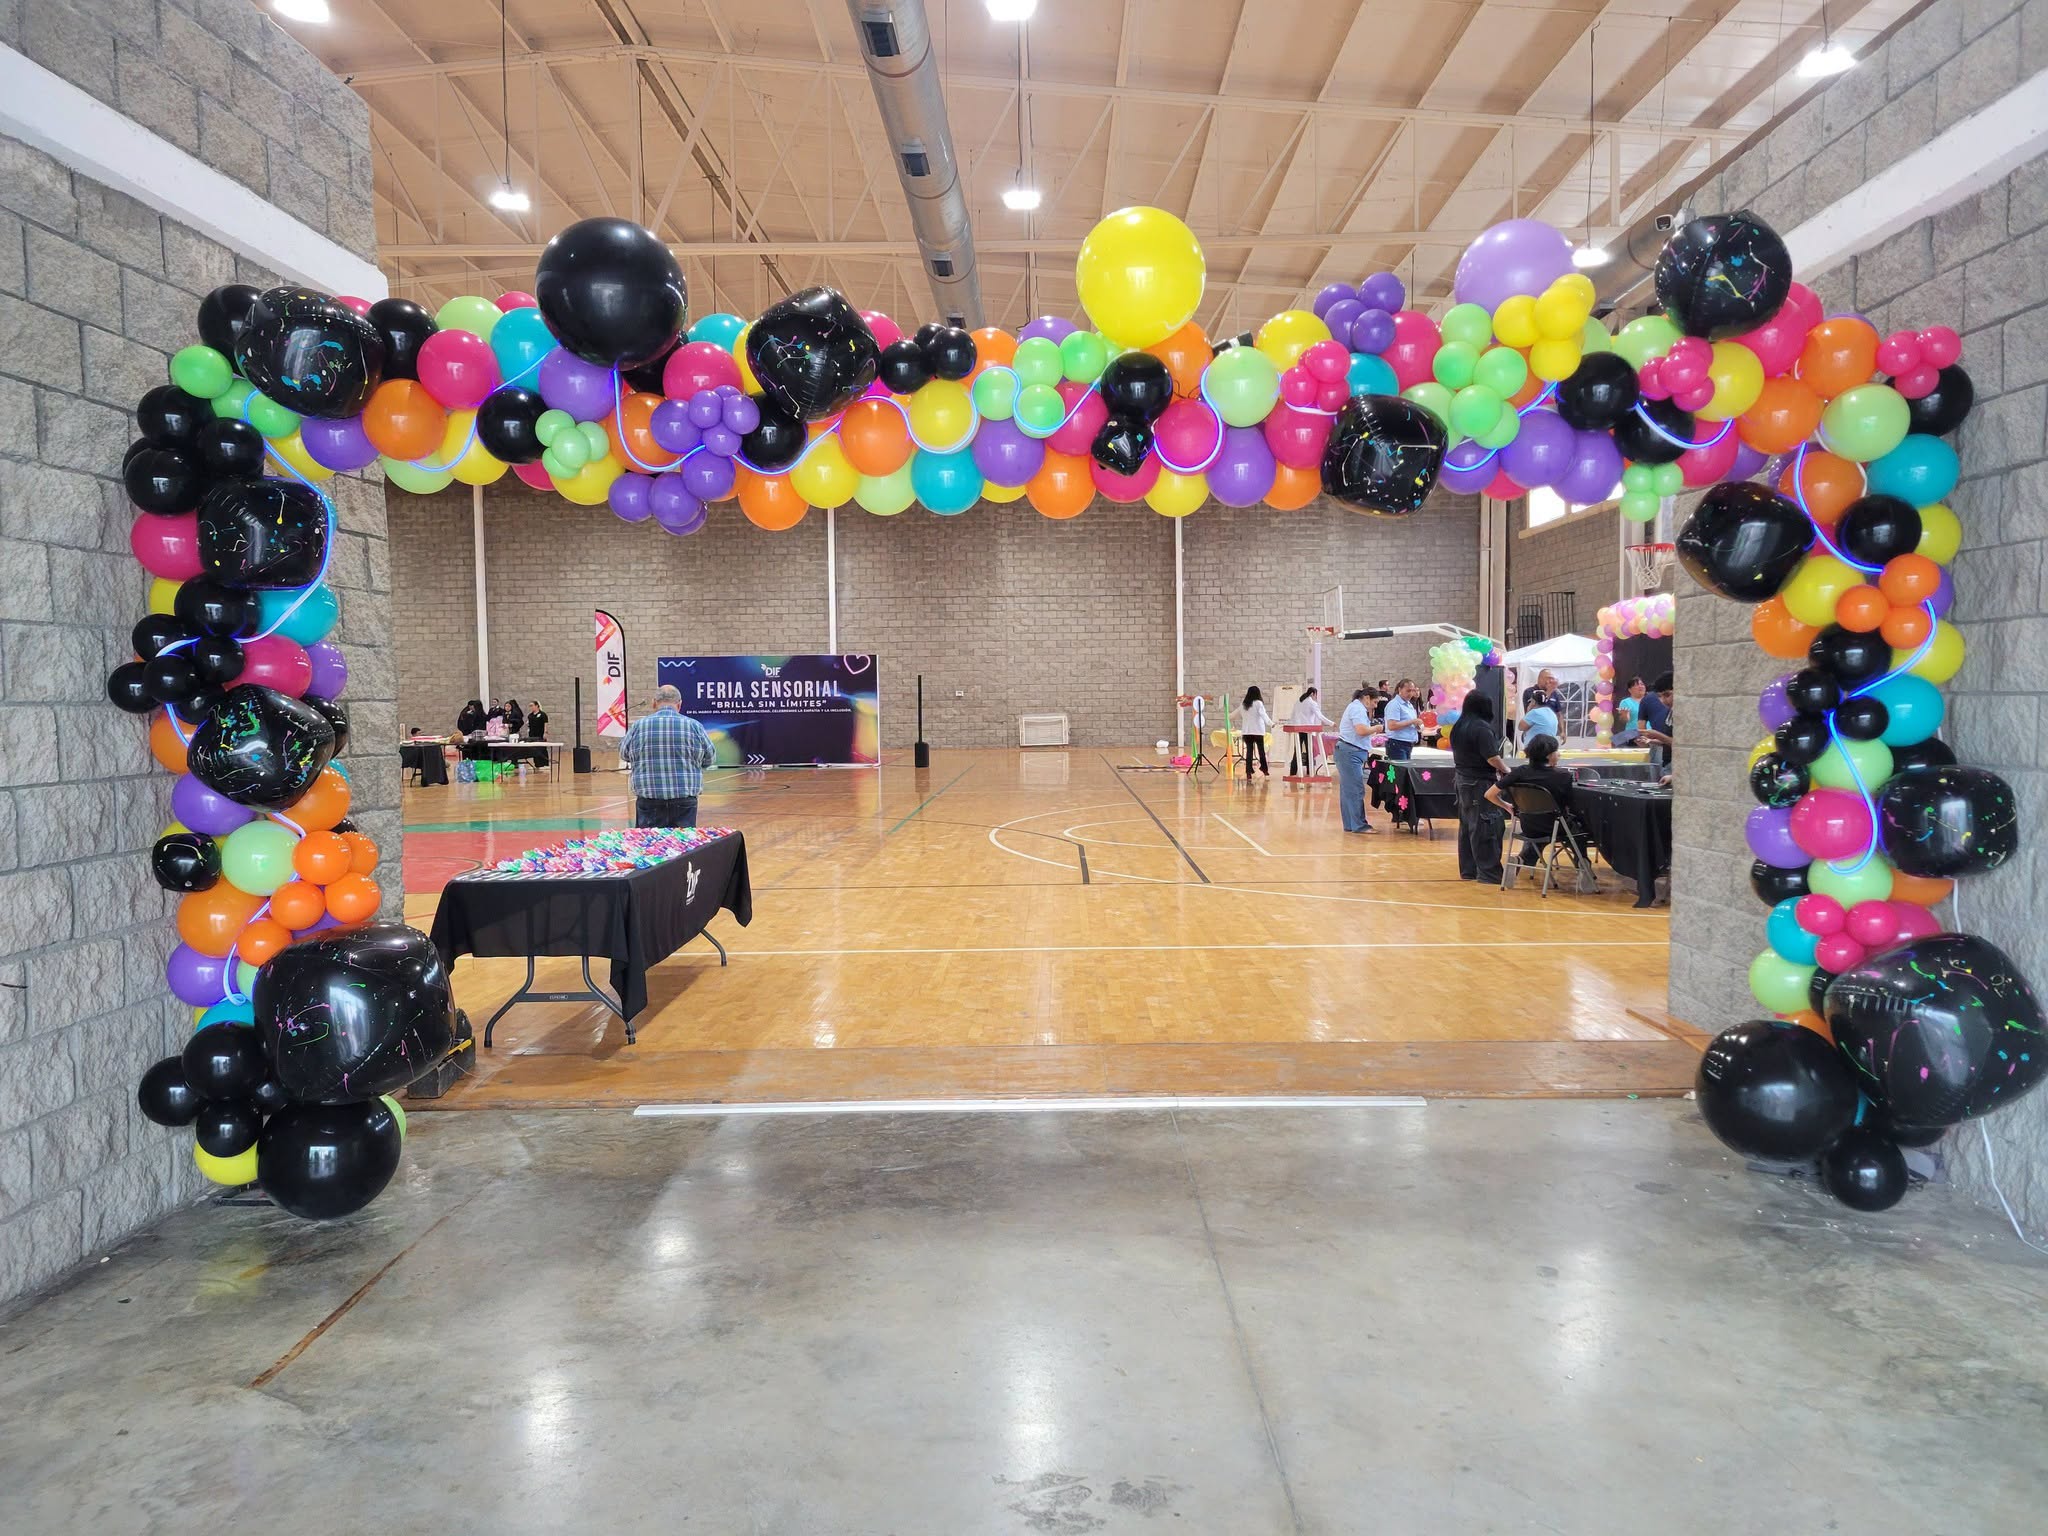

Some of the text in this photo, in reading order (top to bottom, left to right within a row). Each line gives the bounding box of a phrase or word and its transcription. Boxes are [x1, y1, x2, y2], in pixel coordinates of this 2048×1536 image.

[608, 651, 621, 678] DIF
[765, 667, 782, 676] DIF
[697, 680, 842, 699] FERIA SENSORIAL
[758, 700, 776, 708] SIN
